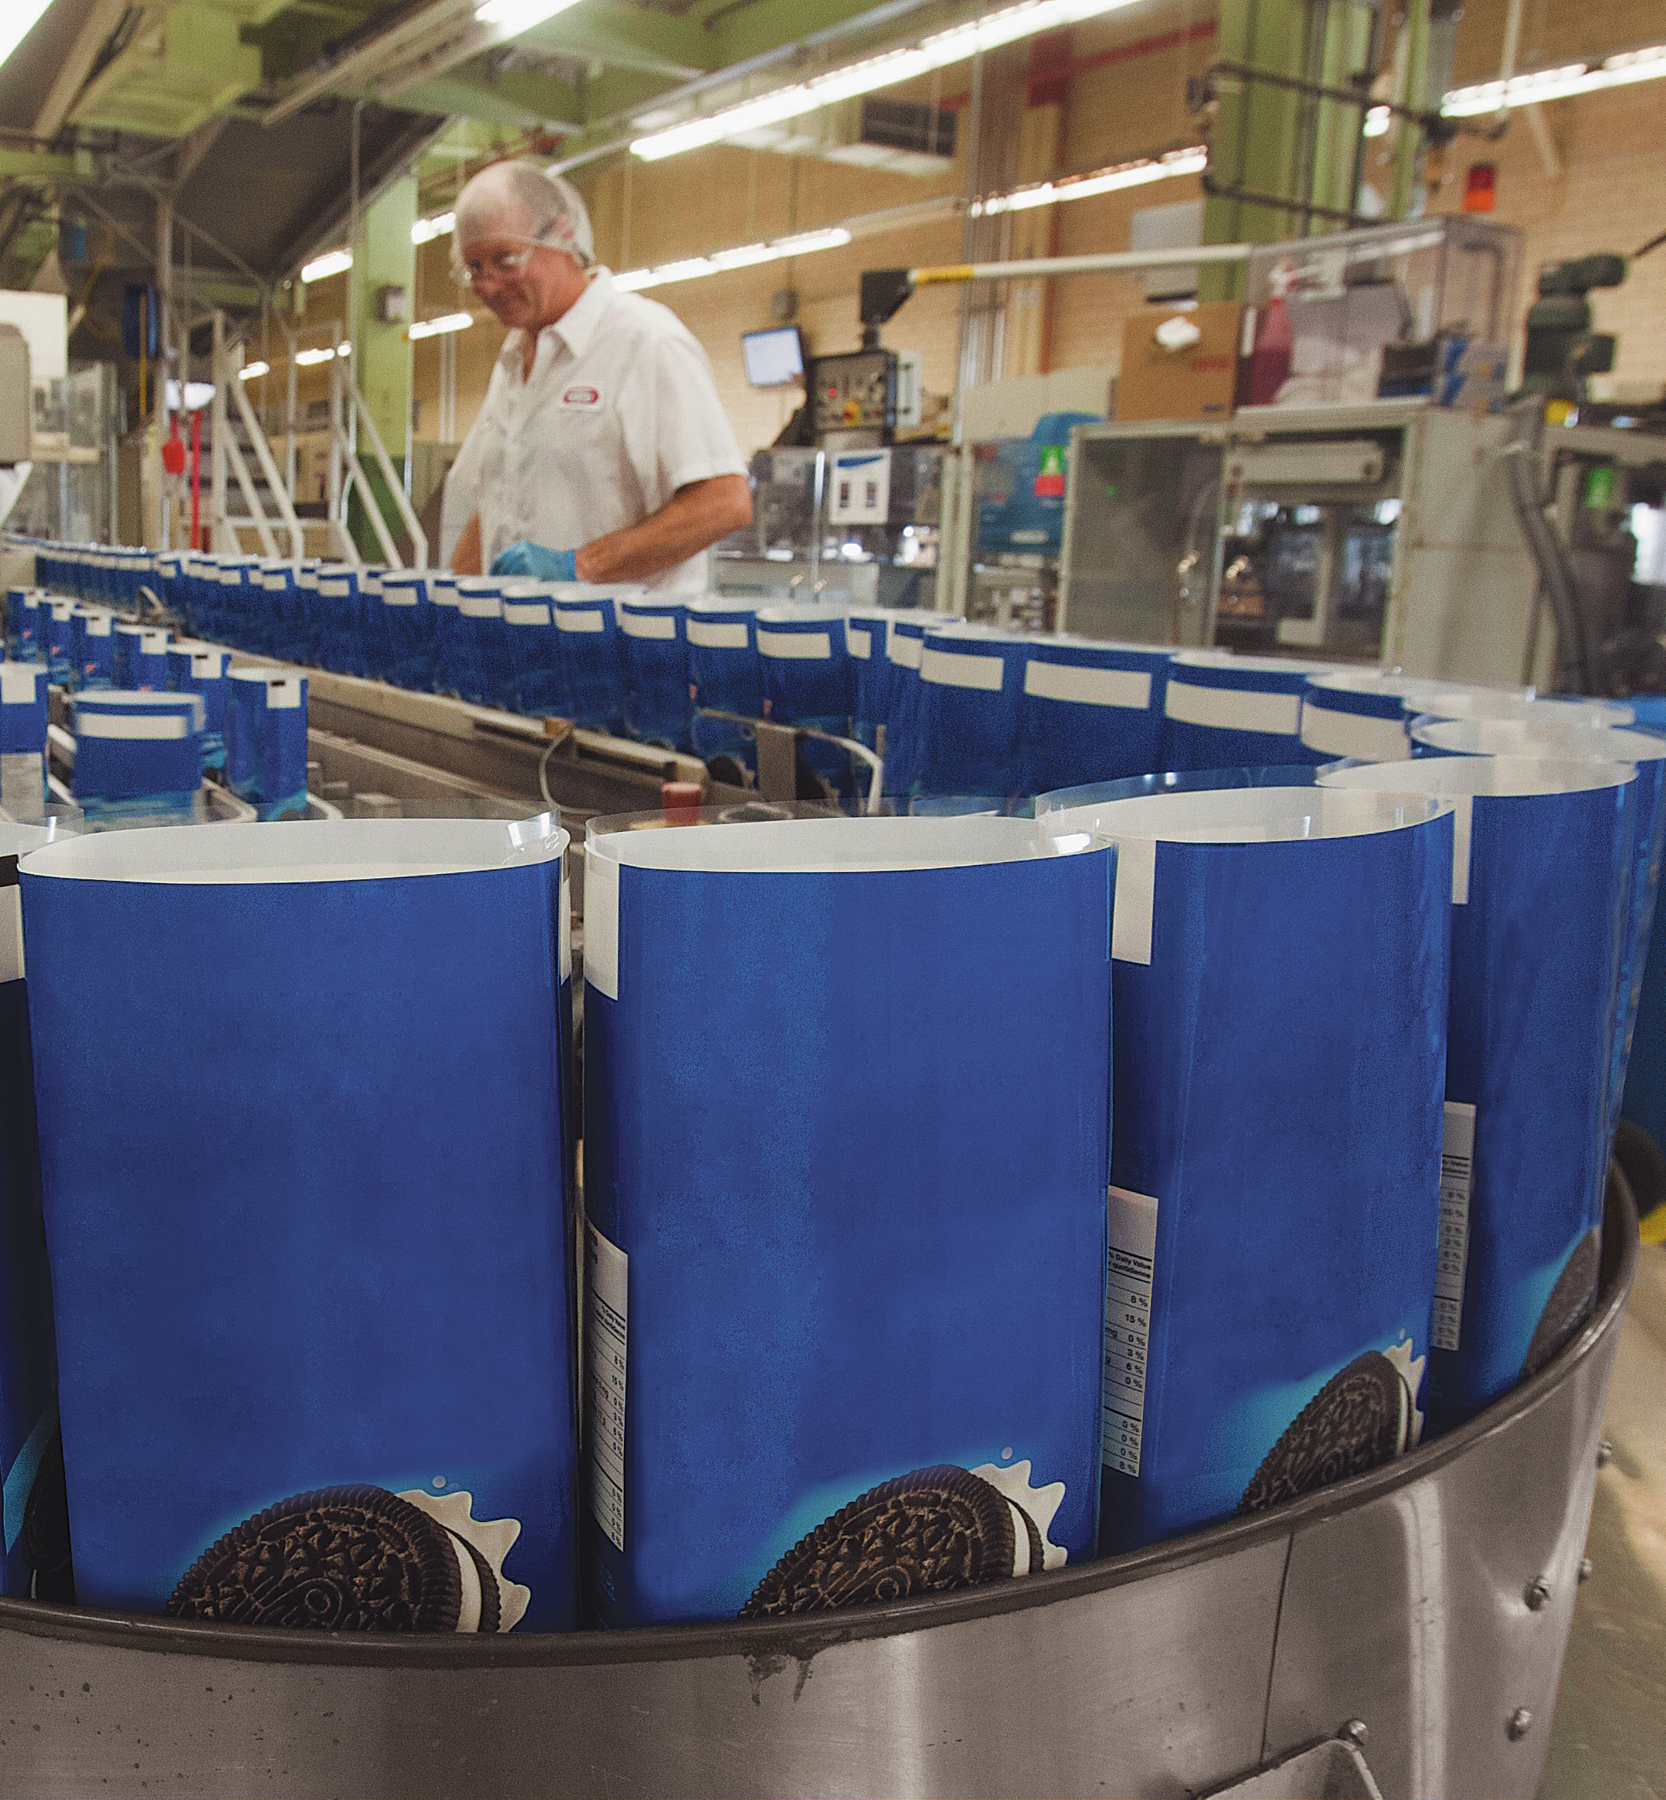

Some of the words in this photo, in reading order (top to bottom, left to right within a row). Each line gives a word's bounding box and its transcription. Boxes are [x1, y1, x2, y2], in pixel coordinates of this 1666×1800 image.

[1116, 1254, 1131, 1265] Daily
[1133, 1260, 1151, 1270] Value
[1138, 1317, 1146, 1327] %
[1137, 1337, 1145, 1347] %
[1136, 1351, 1144, 1361] %
[1135, 1365, 1143, 1375] %
[1134, 1379, 1143, 1389] %
[1131, 1423, 1139, 1433] %
[1130, 1437, 1138, 1447] %
[1129, 1451, 1138, 1460] %
